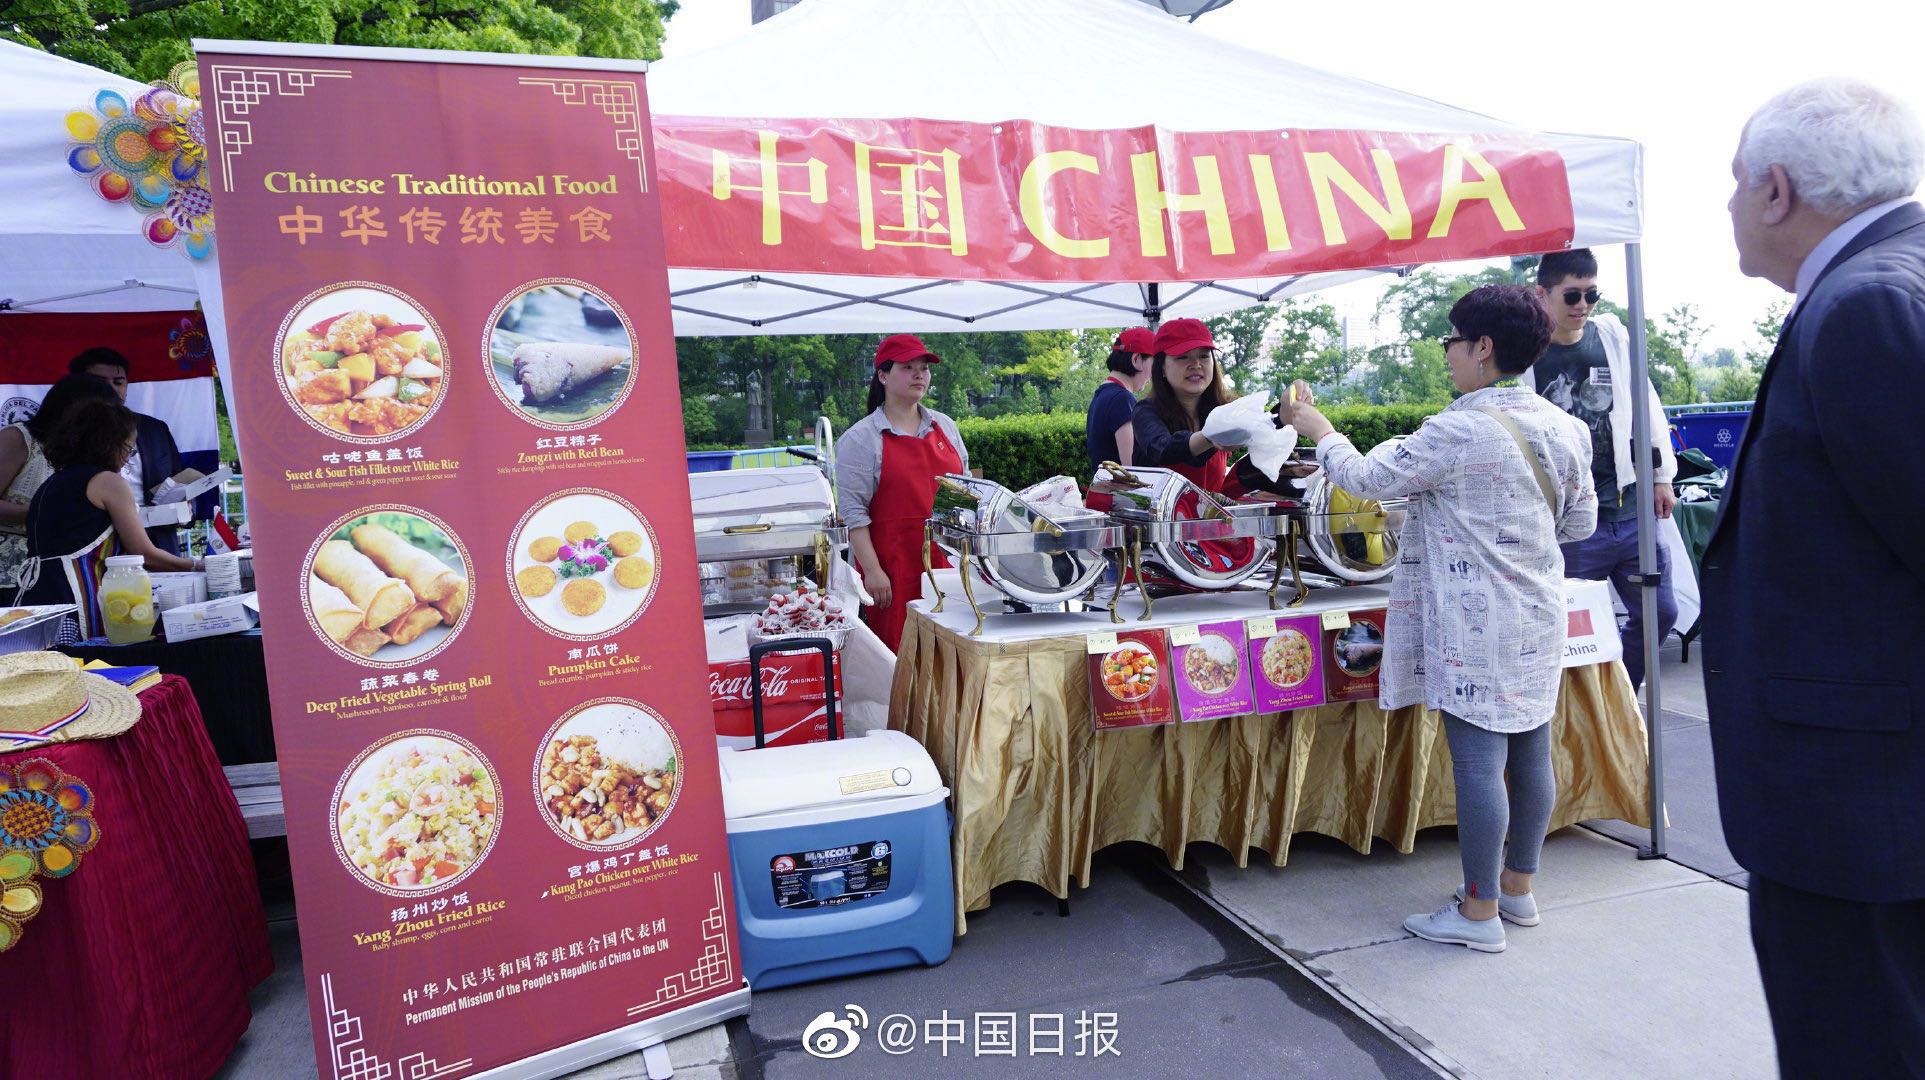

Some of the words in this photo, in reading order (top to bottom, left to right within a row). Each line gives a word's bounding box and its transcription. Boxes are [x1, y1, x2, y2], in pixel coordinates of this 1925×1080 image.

[264, 171, 385, 194] Chinese
[391, 173, 546, 196] Traditional
[552, 174, 618, 195] Food
[712, 129, 968, 256] 中国
[1020, 143, 1527, 258] CHINA
[278, 204, 613, 246] 中华传统美食
[518, 452, 551, 465] Zongzi
[555, 452, 575, 461] with
[579, 449, 597, 459] Red
[600, 447, 624, 457] Bean
[536, 434, 602, 450] 红豆粽子
[286, 469, 312, 481] Sweet
[315, 468, 323, 479] &
[326, 467, 346, 478] Sour
[349, 465, 367, 476] Fish
[369, 464, 391, 475] Fillet
[392, 464, 411, 474] over
[412, 460, 440, 472] White
[441, 459, 459, 469] Rice
[291, 483, 302, 491] Fish
[548, 659, 606, 676] Pumpkin
[609, 654, 640, 667] Cake
[567, 642, 618, 660] 南瓜饼
[360, 668, 440, 692] 蔬菜春卷
[539, 678, 557, 687] Bread
[559, 675, 584, 683] crumbs,
[586, 670, 614, 680] pumpkin
[623, 666, 639, 674] sticky
[306, 701, 337, 714] Deep
[340, 694, 370, 708] Fried
[372, 686, 427, 705] Vegetable
[430, 682, 466, 696] Spring
[469, 675, 492, 688] Roll
[337, 708, 381, 720] Mushroom,
[383, 702, 416, 712] bamboo,
[417, 698, 441, 707] carrots
[451, 693, 467, 702] flour
[551, 883, 575, 895] Kung
[577, 877, 593, 889] Pao
[595, 870, 631, 884] Chicken
[633, 867, 651, 875] over
[652, 858, 679, 870] White
[680, 853, 698, 864] Rice
[568, 844, 670, 878] 宫爆鸡丁盖饭
[564, 893, 583, 902] Diced
[609, 880, 632, 892] peanut,
[633, 877, 643, 885] hot
[645, 871, 667, 882] pepper,
[390, 892, 470, 922] 扬州炒饭
[353, 929, 391, 945] Yang
[395, 918, 434, 936] Zhou
[437, 906, 473, 924] Fried
[476, 900, 507, 914] Rice
[372, 941, 390, 951] Baby
[392, 935, 419, 947] shrimp,
[422, 930, 439, 940] eggs,
[440, 925, 456, 934] corn
[457, 921, 471, 930] and
[472, 916, 493, 925] carrot
[402, 917, 666, 1006] 中华人民共和国常驻联合国代表团
[405, 1003, 458, 1026] Permanent
[459, 991, 495, 1010] Mission
[496, 986, 505, 999] of
[506, 983, 521, 997] the
[522, 971, 559, 990] People's
[561, 960, 598, 980] Republic
[599, 958, 607, 969] of
[608, 950, 631, 966] China
[633, 947, 641, 959] to
[642, 944, 656, 955] the
[657, 938, 669, 952] UN
